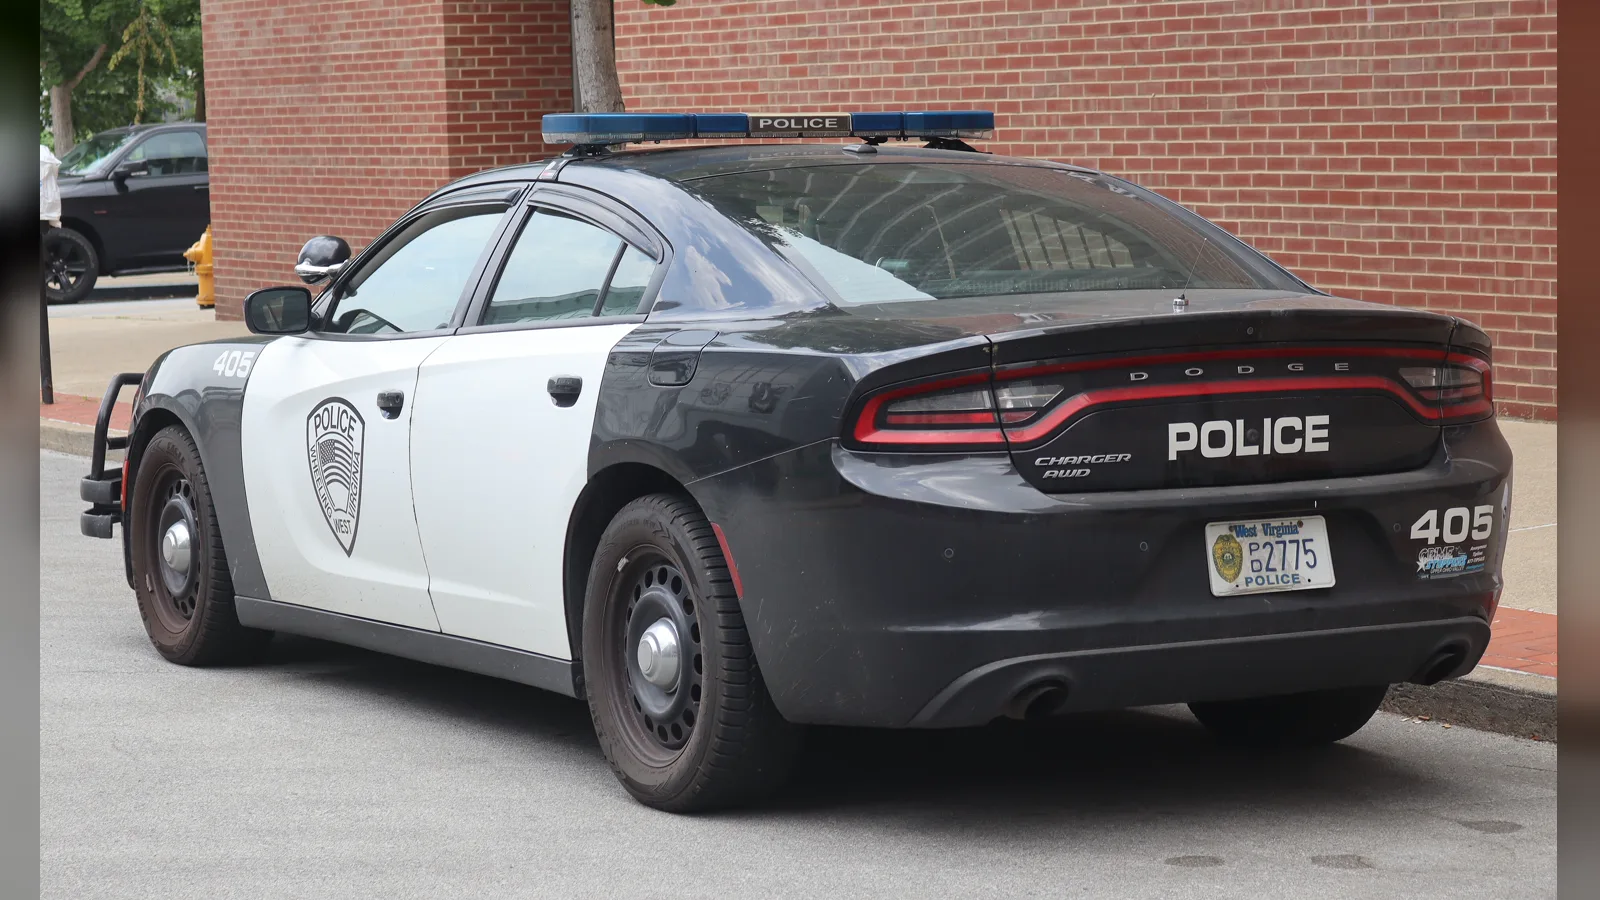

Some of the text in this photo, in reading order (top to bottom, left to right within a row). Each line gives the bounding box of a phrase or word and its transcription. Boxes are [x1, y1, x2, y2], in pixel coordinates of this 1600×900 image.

[759, 118, 838, 129] POLICE
[212, 350, 255, 378] 405
[1129, 362, 1350, 382] DODGE
[314, 405, 357, 442] POLICE
[1168, 414, 1330, 461] POLICE
[1034, 453, 1132, 466] CHARGER
[310, 444, 333, 519] WHEELING
[347, 451, 361, 519] VIRGINIA
[1042, 468, 1091, 479] AWD
[333, 518, 352, 535] WEST
[1234, 522, 1299, 538] West Virginia
[1410, 504, 1494, 545] 405
[1263, 539, 1317, 572] 2775
[1245, 574, 1301, 587] POLICE
